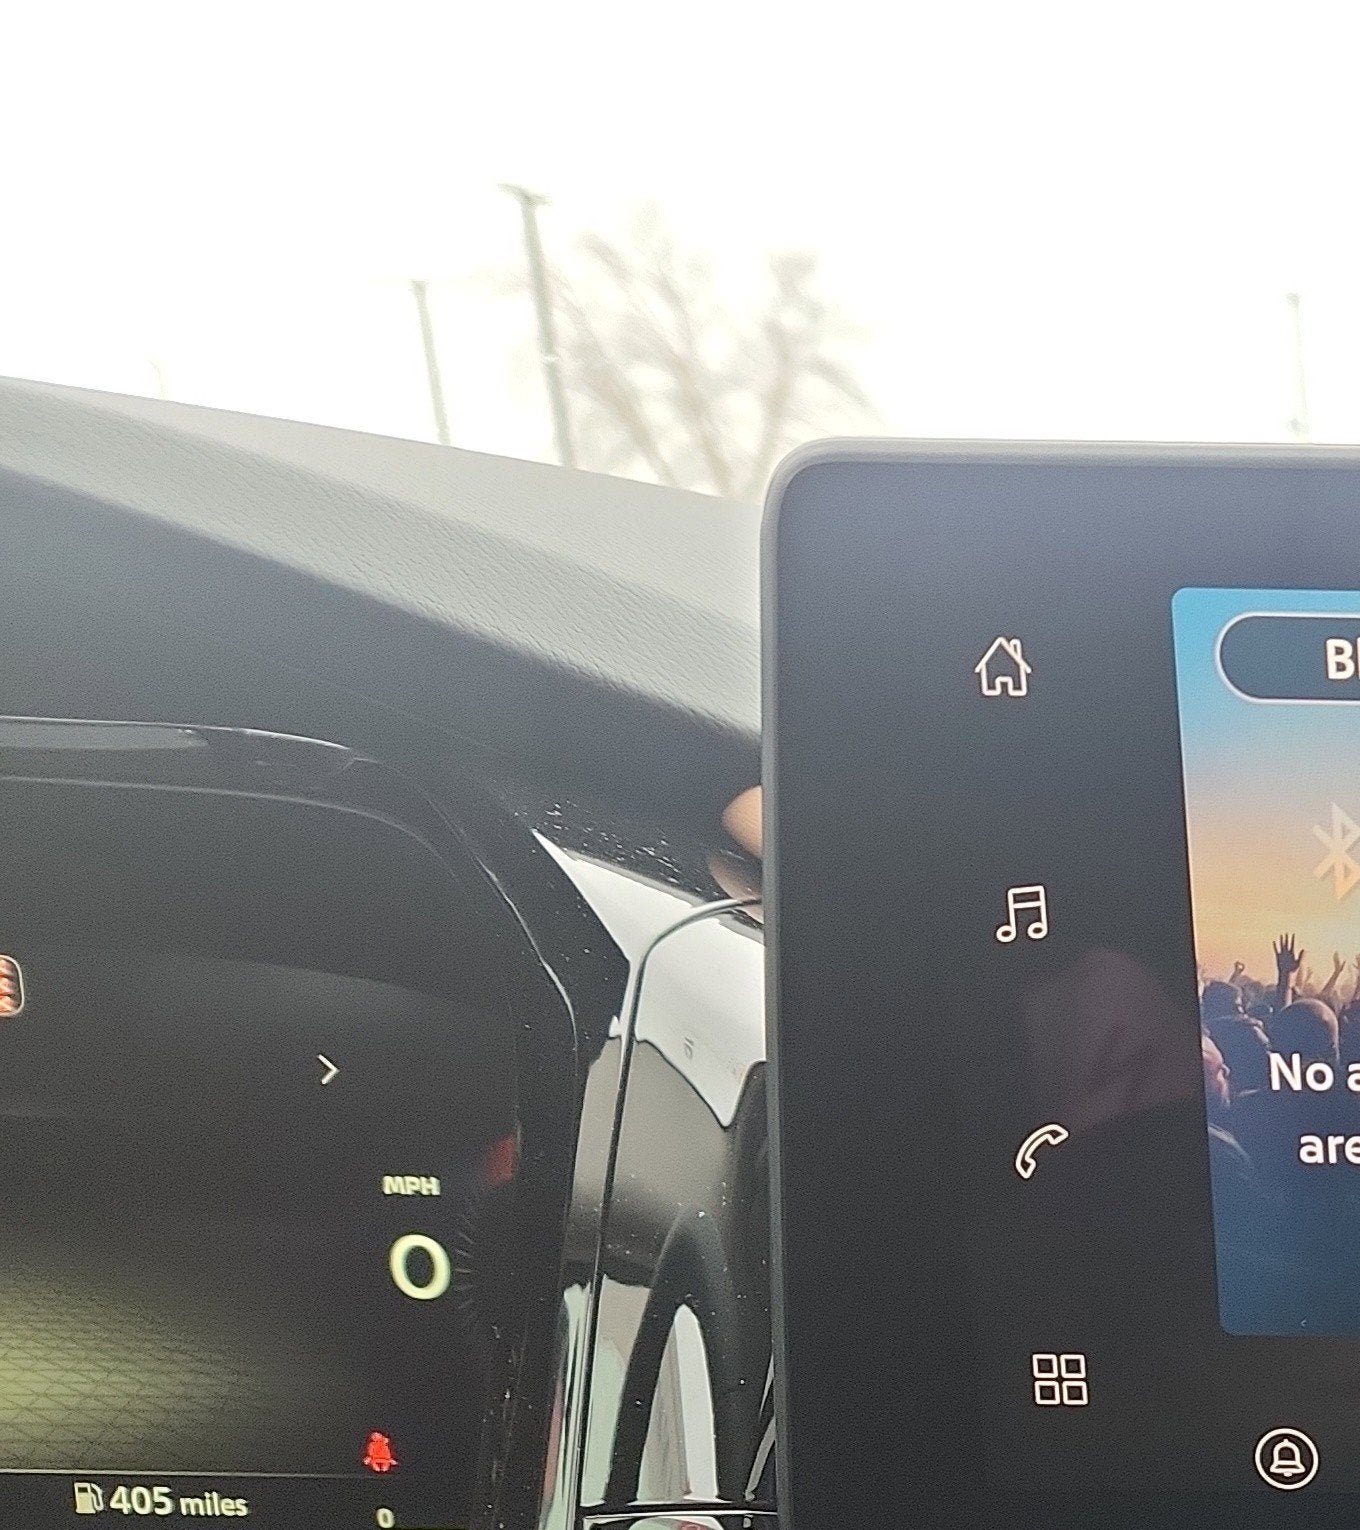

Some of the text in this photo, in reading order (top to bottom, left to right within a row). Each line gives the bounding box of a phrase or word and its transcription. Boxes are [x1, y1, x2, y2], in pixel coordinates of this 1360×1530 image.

[1268, 1051, 1339, 1091] No
[382, 1175, 441, 1196] MPH
[389, 1234, 451, 1300] 0
[109, 1485, 249, 1517] 405 miles
